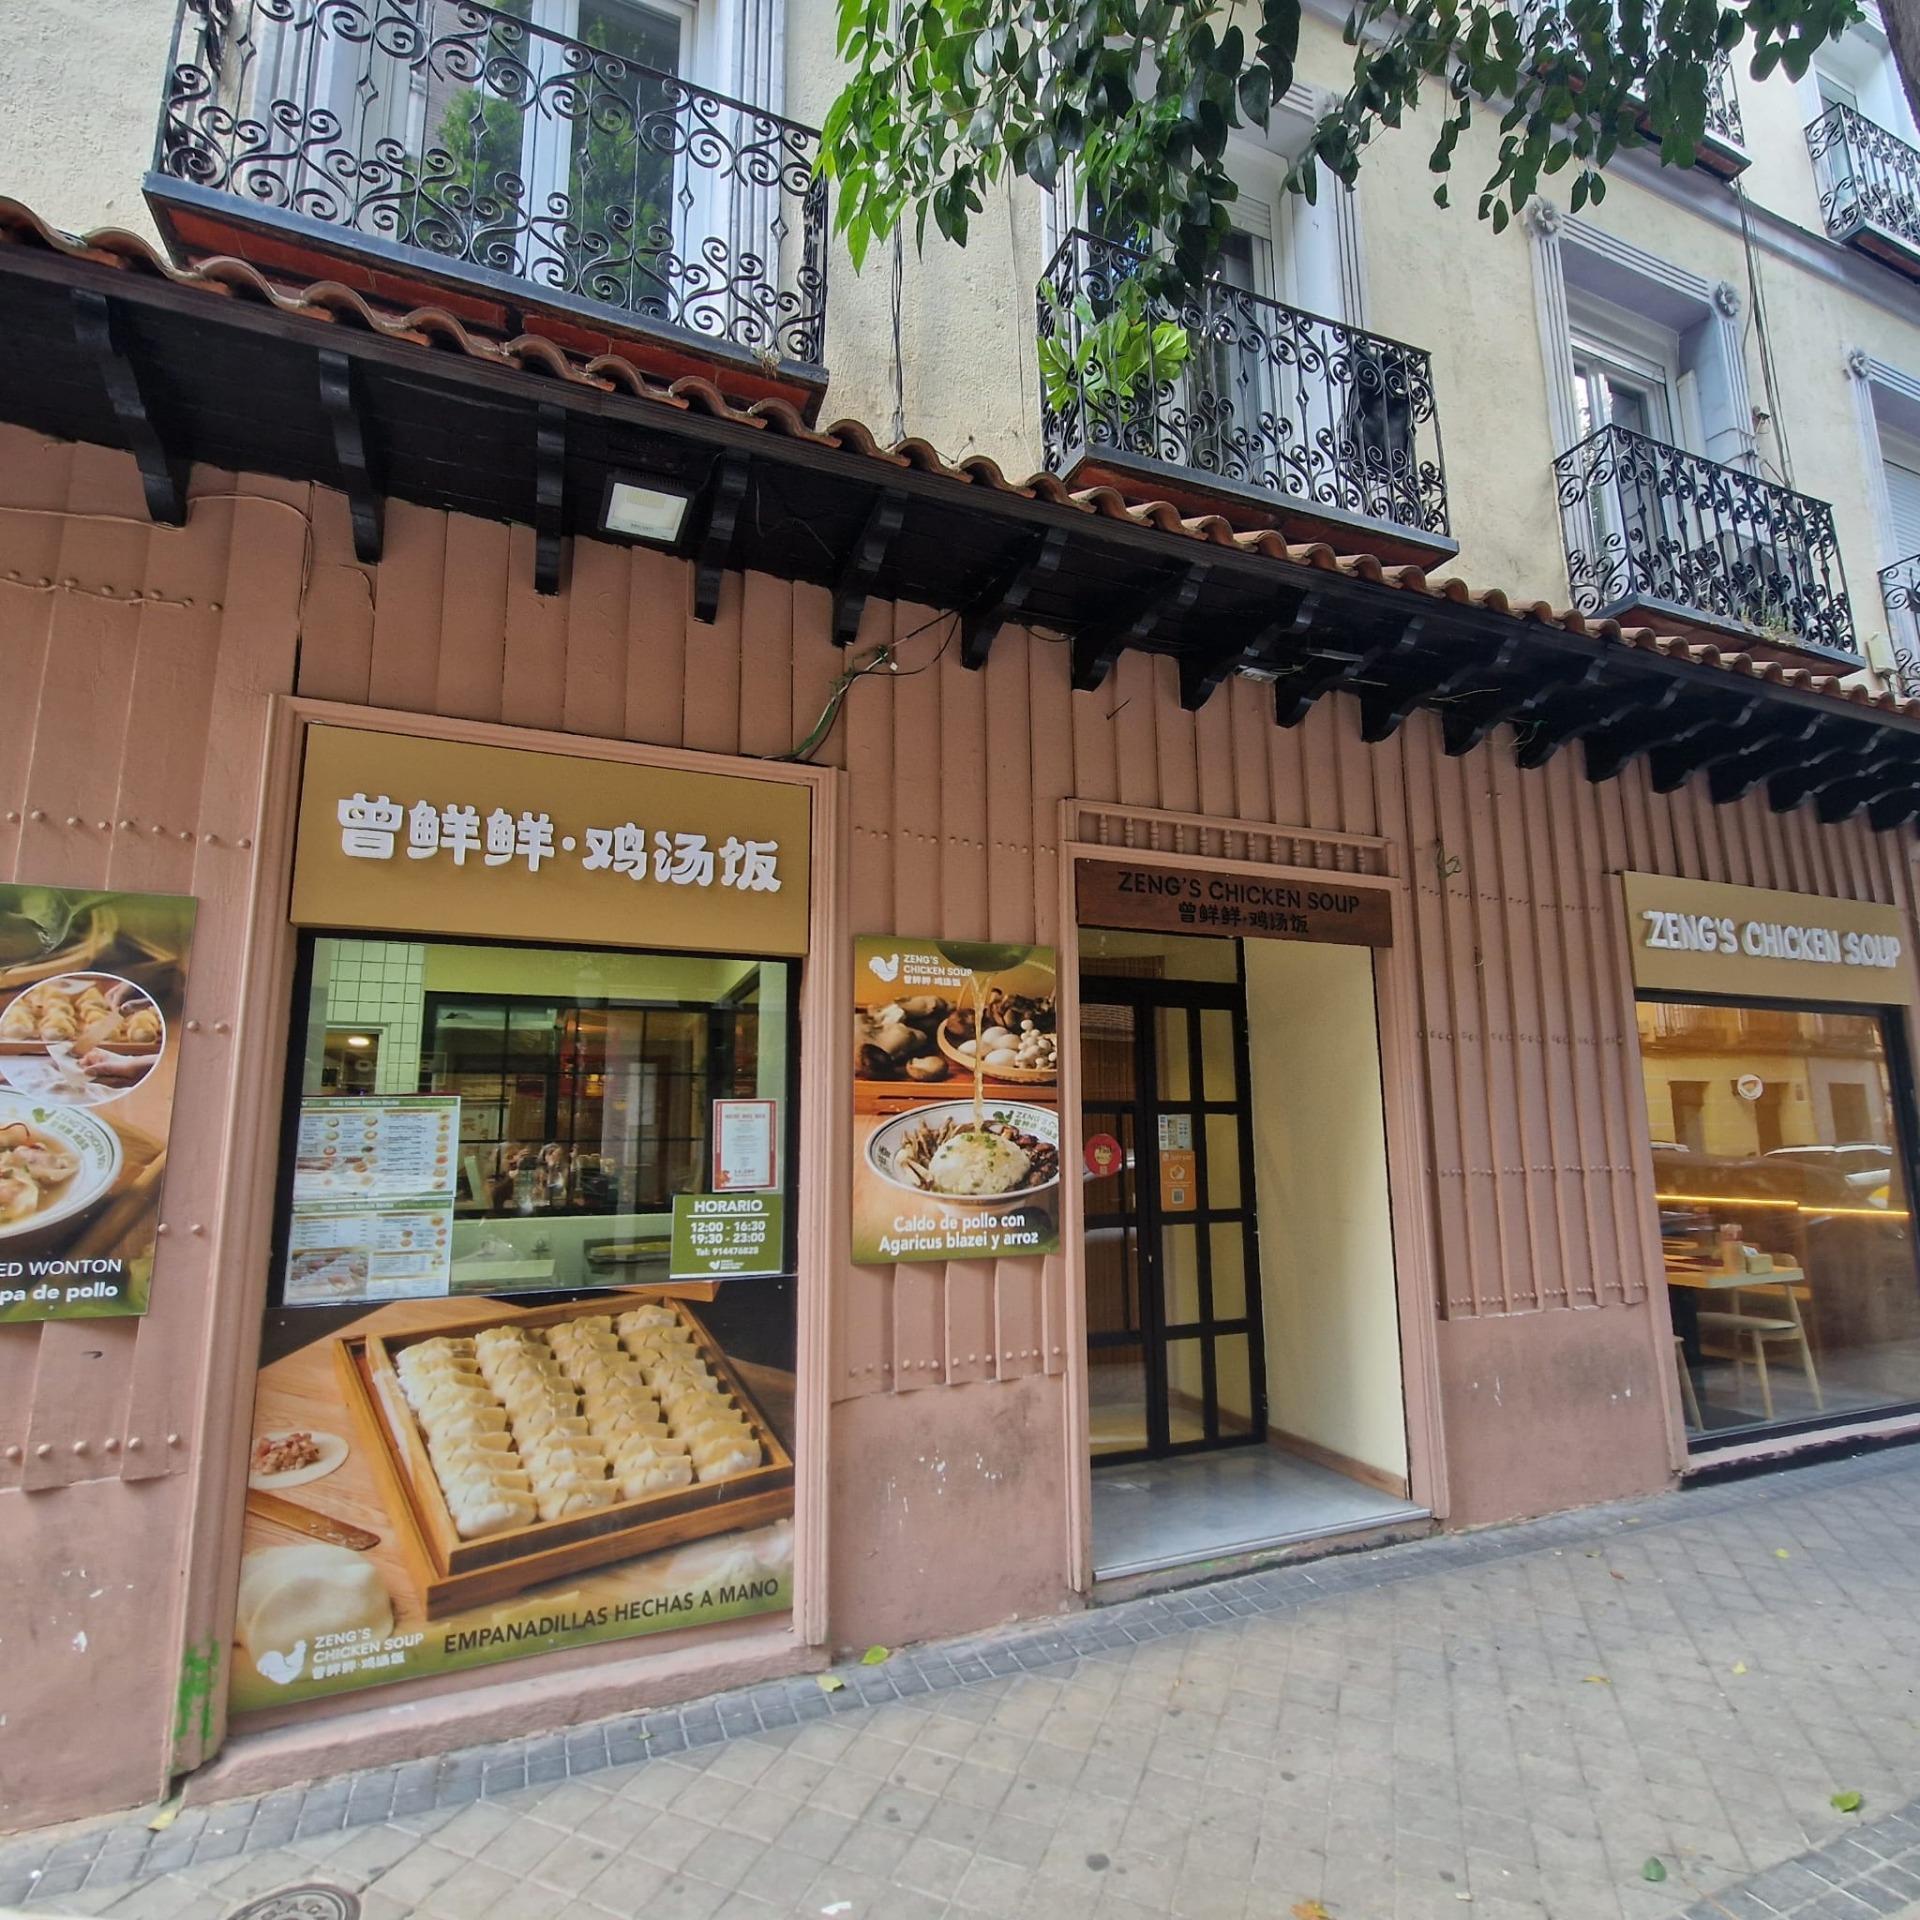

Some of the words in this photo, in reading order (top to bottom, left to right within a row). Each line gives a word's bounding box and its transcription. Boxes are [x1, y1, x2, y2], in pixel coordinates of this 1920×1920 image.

[337, 793, 782, 893] 曾鲜鲜·鸡汤饭
[1118, 871, 1201, 897] ZENG'S
[1209, 881, 1301, 909] CHICKEN
[1308, 892, 1360, 914] SOUP
[1642, 910, 1738, 953] ZENG'S
[1742, 921, 1841, 964] CHICKEN
[1843, 931, 1901, 968] SOUP
[903, 954, 939, 965] ZENG'S
[903, 964, 946, 976] CHICKEN
[947, 968, 973, 977] SOUP
[694, 1200, 763, 1213] HORARIO
[690, 1221, 724, 1233] 12:00
[733, 1220, 766, 1232] 16:30
[894, 1215, 936, 1232] Caldo
[940, 1214, 957, 1229] de
[962, 1212, 997, 1229] pollo
[1001, 1214, 1026, 1227] con
[690, 1233, 723, 1245] 19:30
[732, 1232, 766, 1244] 23:00
[879, 1235, 942, 1255] Agaricus
[946, 1231, 988, 1248] blazei
[991, 1234, 1000, 1249] y
[1003, 1231, 1039, 1244] arroz
[28, 1259, 122, 1276] WONTON
[32, 1284, 60, 1300] de
[66, 1281, 119, 1303] pollo
[444, 1607, 607, 1654] EMPANADILLAS
[614, 1592, 694, 1622] HECHAS
[700, 1590, 713, 1607] A
[719, 1578, 779, 1604] MANO
[313, 1640, 380, 1663] CHICKEN
[384, 1633, 424, 1651] SOUP
[314, 1627, 371, 1649] ZENG'S
